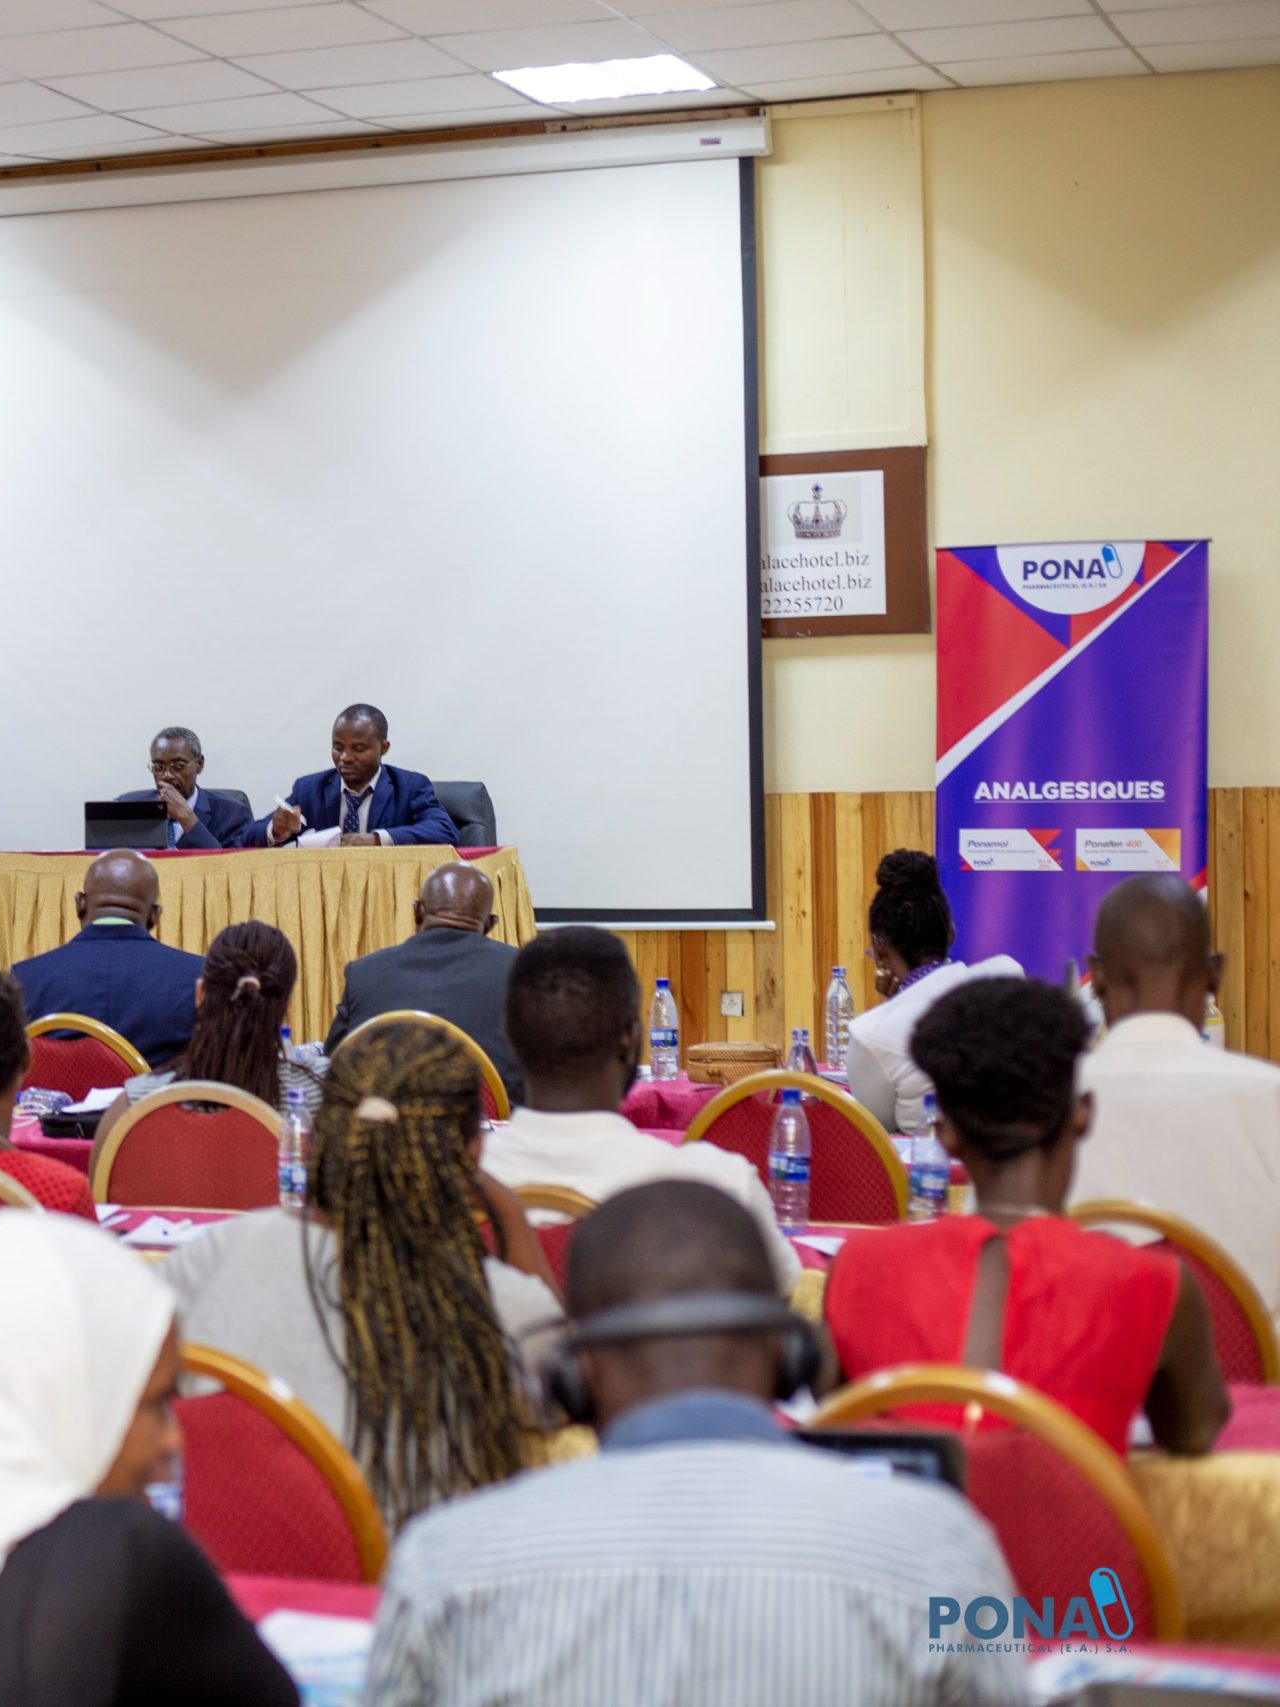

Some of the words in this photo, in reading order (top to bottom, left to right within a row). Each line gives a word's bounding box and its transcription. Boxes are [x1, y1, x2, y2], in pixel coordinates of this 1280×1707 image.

[1022, 558, 1106, 581] PONA
[763, 596, 844, 614] 22255720
[974, 780, 1165, 800] ANALGESIQUES
